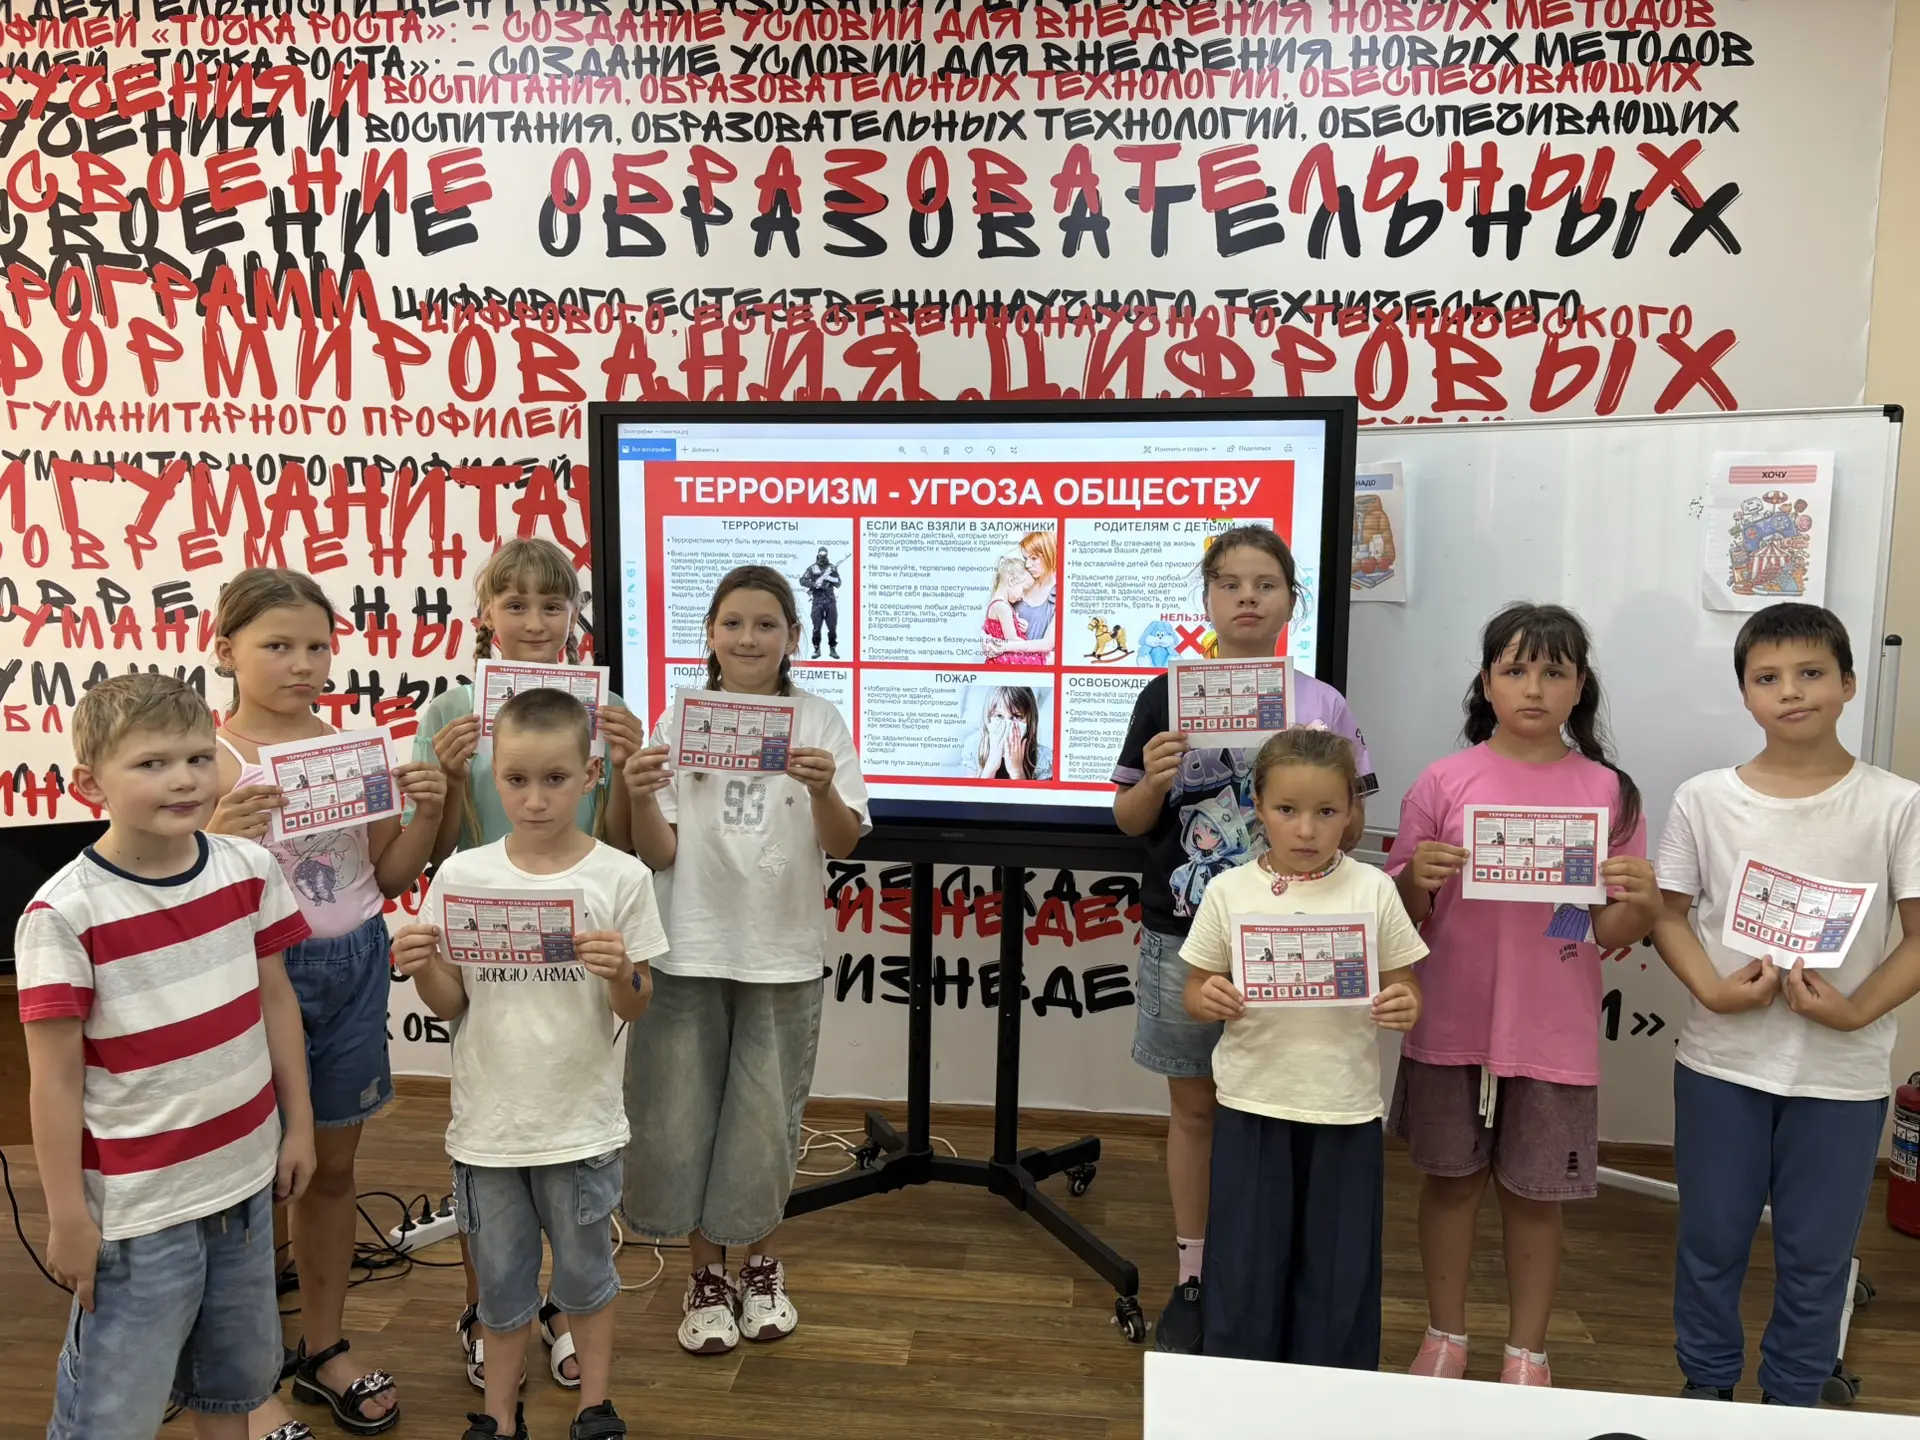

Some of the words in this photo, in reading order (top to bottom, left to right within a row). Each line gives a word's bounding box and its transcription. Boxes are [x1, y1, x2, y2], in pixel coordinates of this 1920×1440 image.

[0, 12, 137, 48] ФИЛЕЙ
[502, 8, 726, 46] СОЗДАНИЕ
[735, 2, 923, 42] УСЛОВИЙ
[933, 5, 1022, 43] ДЛЯ
[1034, 1, 1312, 41] ВНЕДРЕНИЯ
[1328, 0, 1493, 34] НОВЫХ
[1505, 0, 1717, 32] МЕТОДОВ
[489, 44, 721, 81] СОЗДАНИЕ
[730, 40, 926, 79] УСЛОВИЙ
[938, 43, 1029, 81] ДЛЯ
[1041, 37, 1333, 76] ВНЕДРЕНИЯ
[1349, 32, 1520, 70] НОВЫХ
[1534, 30, 1755, 67] МЕТОДОВ
[382, 73, 631, 106] ВОСПИТАНИЯ,
[640, 69, 1020, 104] ОБРАЗОВАТЕЛЬНЫХ
[1027, 64, 1290, 102] ТЕХНОЛОГИЙ,
[1299, 60, 1702, 98] ОБЕСПЕЧИВАЮЩИХ
[366, 111, 622, 146] ВОСПИТАНИЯ,
[632, 109, 1028, 144] ОБРАЗОВАТЕЛЬНЫХ
[1034, 102, 1307, 143] ТЕХНОЛОГИЙ,
[1318, 100, 1740, 139] ОБЕСПЕЧИВАЮЩИХ
[550, 139, 1706, 214] ОБРАЗОВАТЕЛЬНЫХ
[539, 182, 1742, 259] ОБРАЗОВАТЕЛЬНЫХ
[1303, 303, 1693, 340] ТЕХНИЧЕСКОГО
[6, 400, 346, 436] ГУМАНИТАРНОГО
[363, 403, 582, 440] ПРОФИЛЕЙ
[674, 476, 877, 505] ТЕРРОРИЗМ
[908, 477, 1044, 507] УГРОЗА
[1053, 477, 1261, 511] ОБЩЕСТВУ
[1356, 479, 1376, 487] НАДО
[722, 520, 799, 532] ТЕРРОРИСТЫ
[866, 521, 897, 531] ЕСЛИ
[900, 521, 924, 531] ВАС
[927, 521, 966, 531] ВЗЯЛИ
[969, 521, 977, 531] В
[981, 521, 1055, 532] ЗАЛОЖНИКИ
[1094, 522, 1169, 532] РОДИТЕЛЯМ
[1172, 522, 1180, 532] С
[935, 673, 977, 684] ПОЖАР
[1069, 677, 1151, 690] ОСВОБОЖДЕ
[724, 780, 767, 826] 93
[475, 966, 528, 982] GIORGIO
